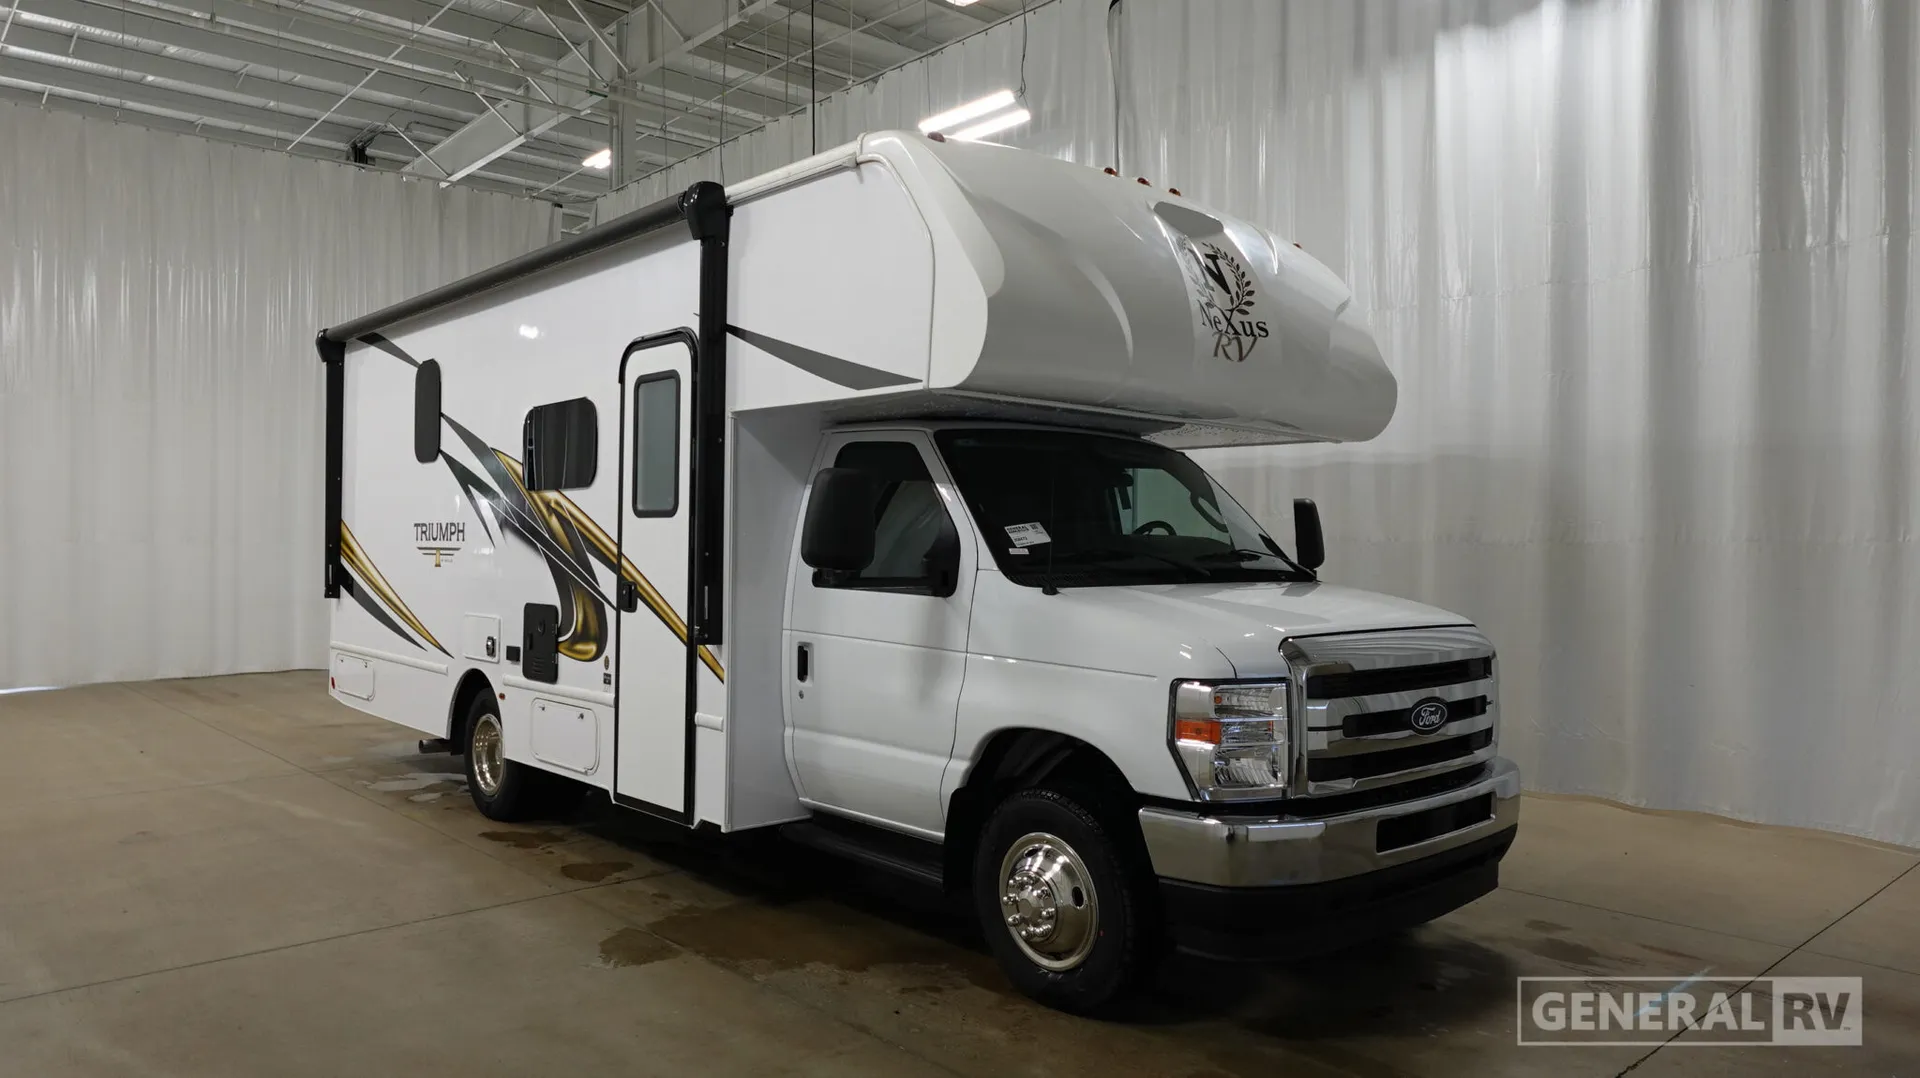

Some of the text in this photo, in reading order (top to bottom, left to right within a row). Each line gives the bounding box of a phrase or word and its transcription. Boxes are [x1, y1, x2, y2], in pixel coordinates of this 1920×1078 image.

[1197, 299, 1269, 338] NeXus
[1212, 331, 1258, 362] RV
[414, 522, 465, 541] TRIUMPH
[1419, 707, 1441, 725] Ford
